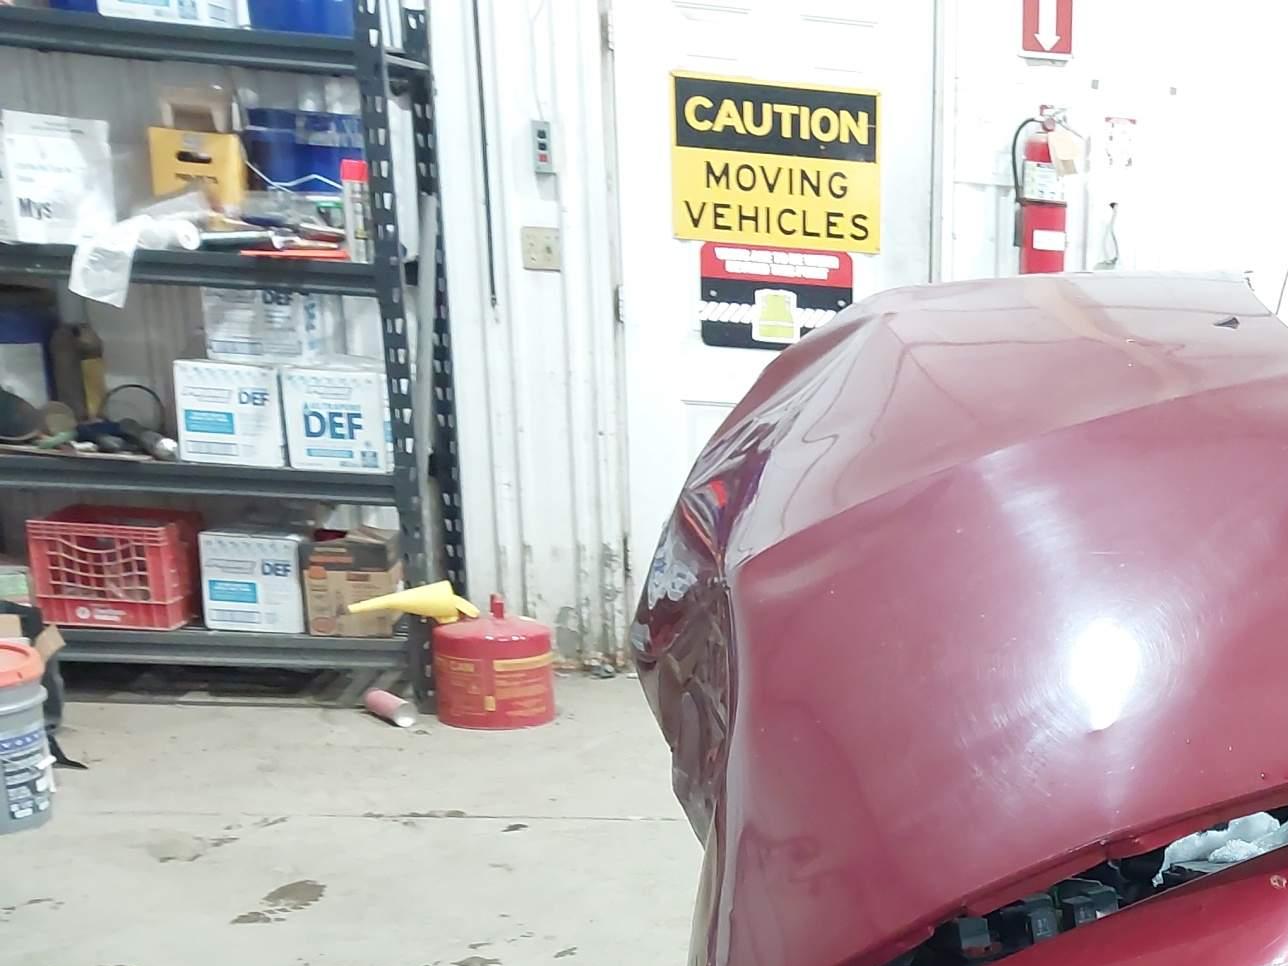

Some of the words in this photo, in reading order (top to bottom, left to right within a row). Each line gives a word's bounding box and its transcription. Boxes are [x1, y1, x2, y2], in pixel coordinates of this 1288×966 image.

[684, 95, 869, 145] CAUTION
[704, 160, 848, 199] MOVING
[684, 200, 869, 241] VEHICLES
[238, 390, 270, 406] DEF
[303, 410, 363, 440] DEF
[261, 562, 291, 577] DEF
